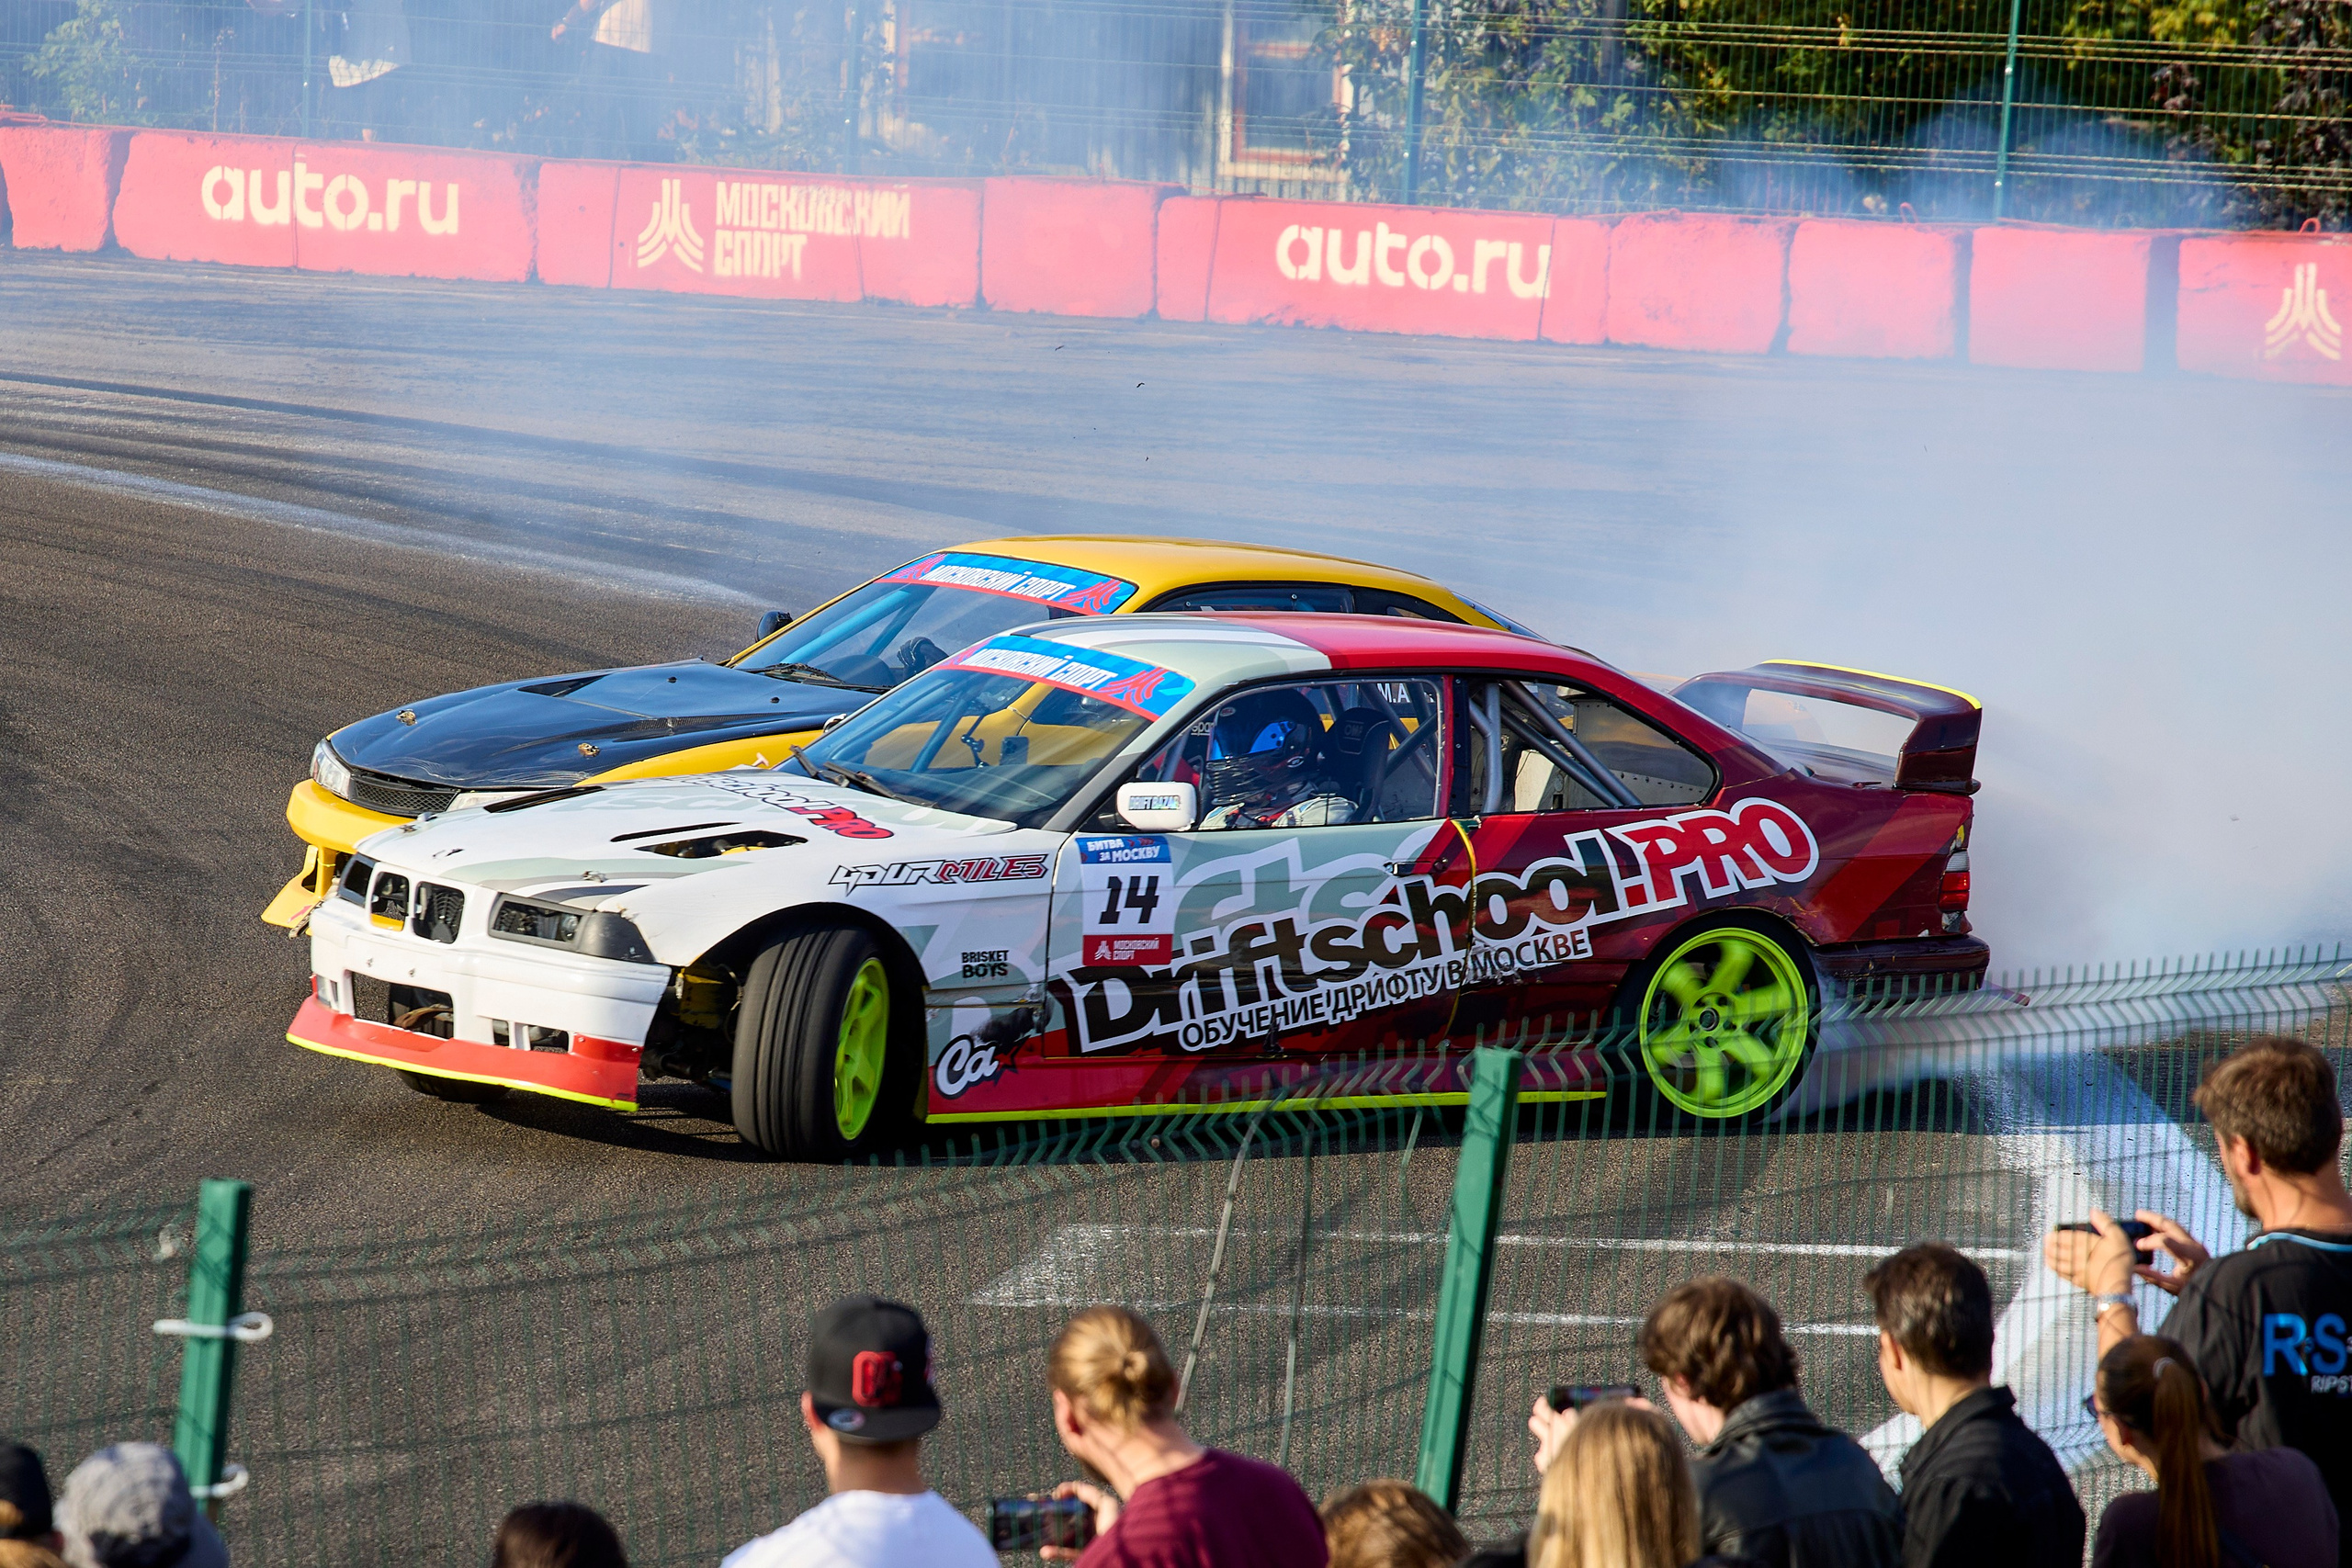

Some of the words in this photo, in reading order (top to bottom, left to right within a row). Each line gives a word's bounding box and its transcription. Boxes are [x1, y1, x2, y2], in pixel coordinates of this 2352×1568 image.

[200, 161, 459, 235] auto.ru
[716, 181, 910, 240] МОСКОВСКИЙ
[714, 229, 808, 281] СПОРТ
[1275, 221, 1552, 299] auto.ru
[919, 564, 1031, 592] МОСКОВСКИЙ
[1008, 575, 1077, 602] СПОРТ
[958, 648, 1073, 678] МОСКОВСКИЙ
[1046, 661, 1119, 691] СПОРТ
[1086, 838, 1125, 852] БИТВА
[1099, 851, 1111, 862] ЗА
[1112, 845, 1160, 863] МОСКВУ
[1098, 875, 1159, 925] 14
[961, 950, 1010, 964] BRISKET
[1113, 937, 1159, 950] МОСКОВСКИЙ
[1113, 950, 1136, 961] СПОРТ
[962, 963, 1009, 978] BOYS
[1182, 992, 1326, 1048] ОБУЧЕНИЕ
[1332, 964, 1445, 1016] ДРИФТУ
[1446, 959, 1464, 986] В
[1469, 928, 1589, 978] МОСКВЕ
